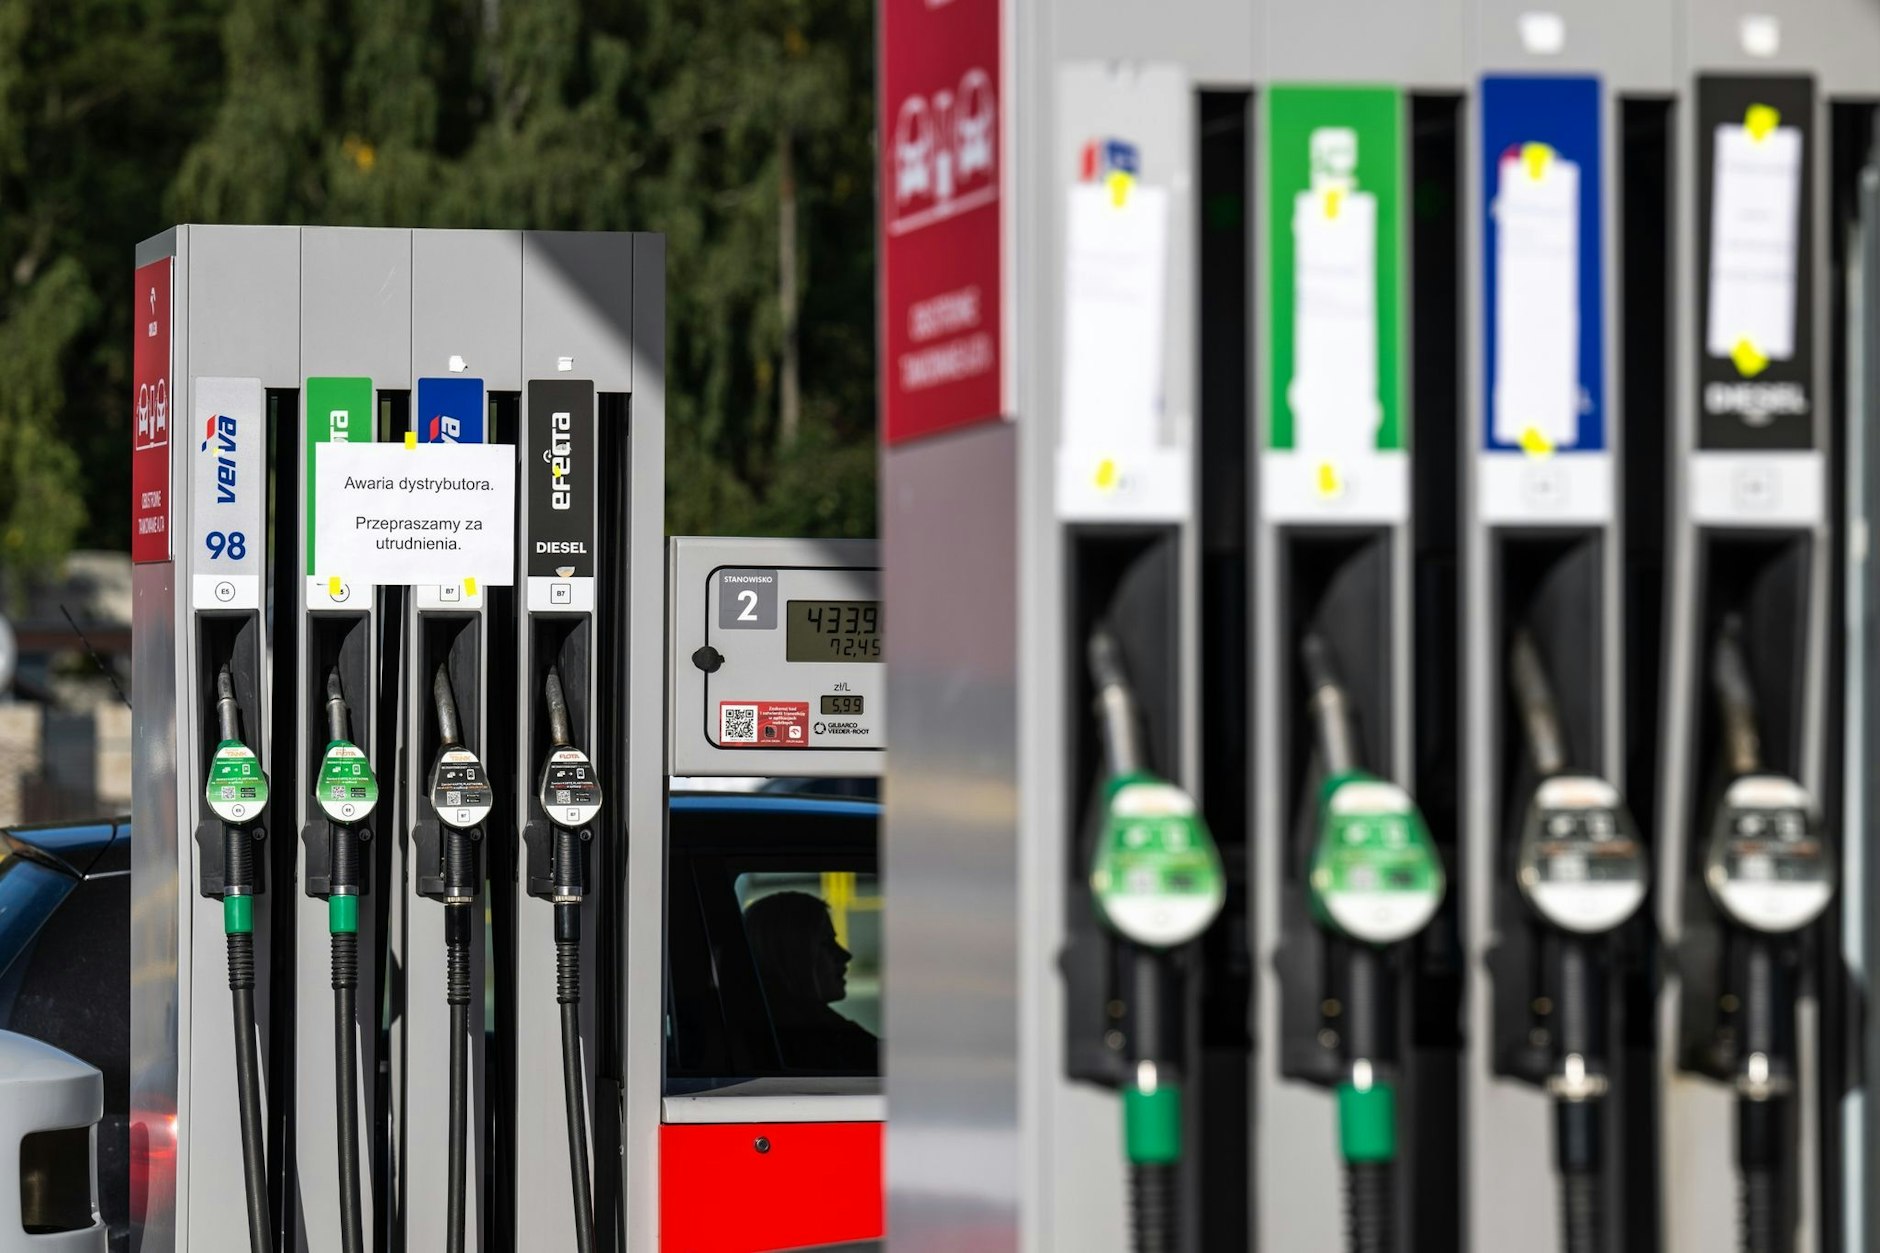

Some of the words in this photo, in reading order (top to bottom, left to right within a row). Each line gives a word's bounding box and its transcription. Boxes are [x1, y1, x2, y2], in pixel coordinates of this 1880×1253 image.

[217, 415, 237, 504] verva
[344, 476, 394, 490] Awaria
[399, 477, 494, 493] dystrybutora.
[355, 516, 461, 533] Przepraszamy
[465, 519, 483, 531] za
[206, 531, 247, 560] 98
[376, 537, 462, 551] utrudnienia.
[536, 542, 588, 554] DIESEL
[724, 575, 773, 584] STANOWISKO
[556, 589, 566, 597] B7
[737, 589, 758, 621] 2
[808, 607, 884, 635] 433,9
[834, 682, 851, 692] zł/L
[832, 698, 862, 712] 5,99
